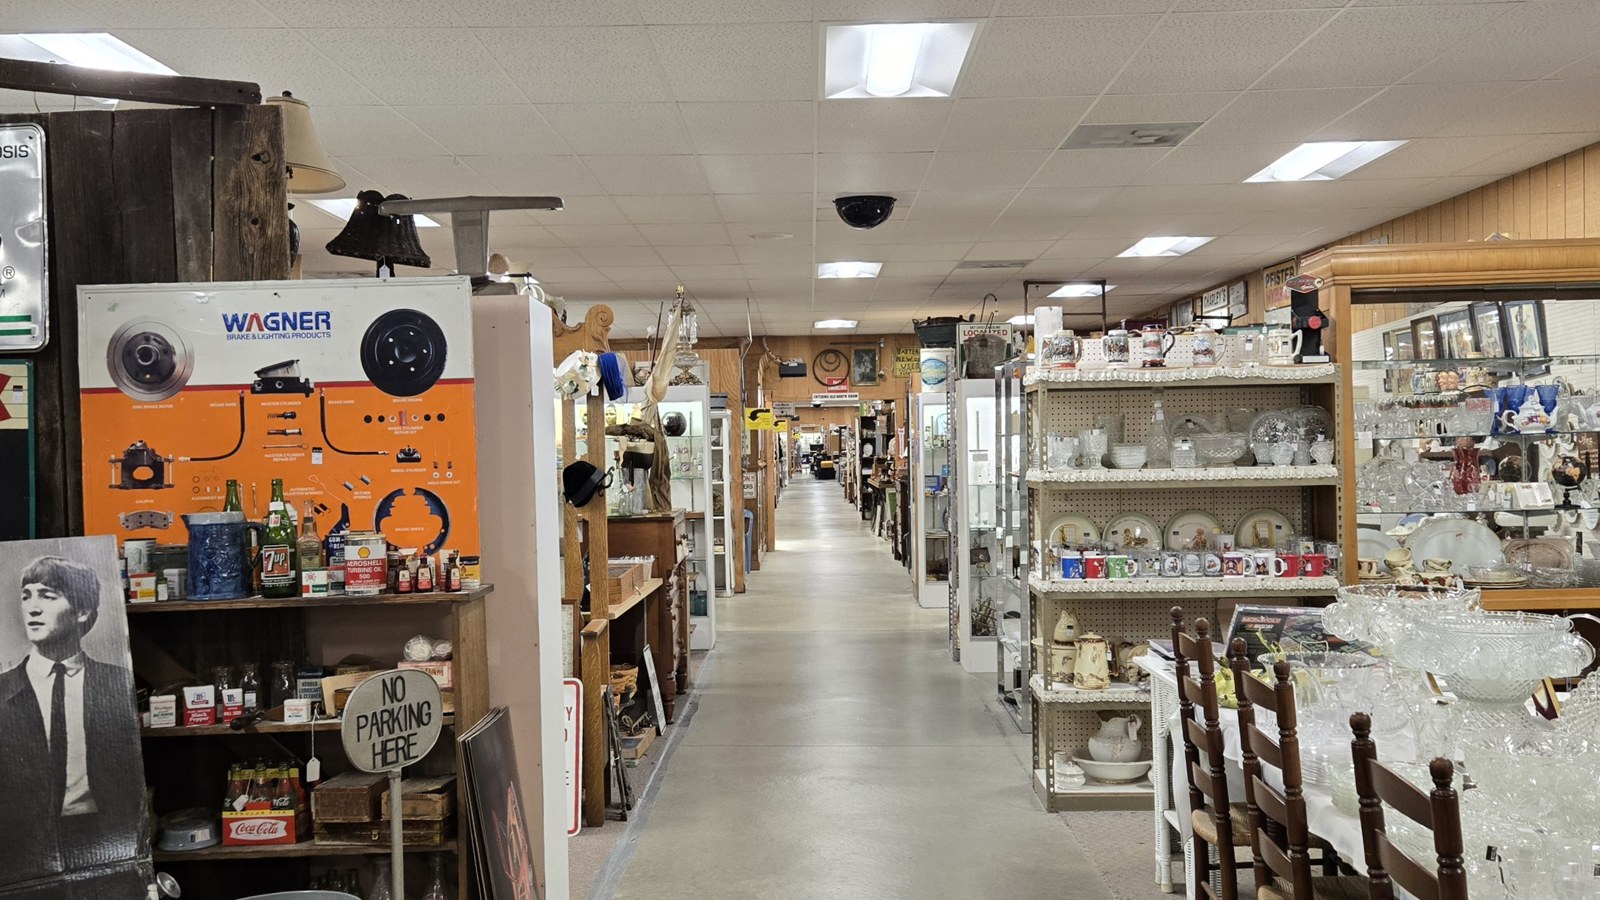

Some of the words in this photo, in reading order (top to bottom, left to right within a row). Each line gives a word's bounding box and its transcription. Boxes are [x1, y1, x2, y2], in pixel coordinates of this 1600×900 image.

[1266, 266, 1294, 288] PFISTER
[222, 311, 331, 332] WAGNER
[382, 675, 406, 706] NO
[356, 701, 432, 743] PARKING
[372, 732, 418, 770] HERE
